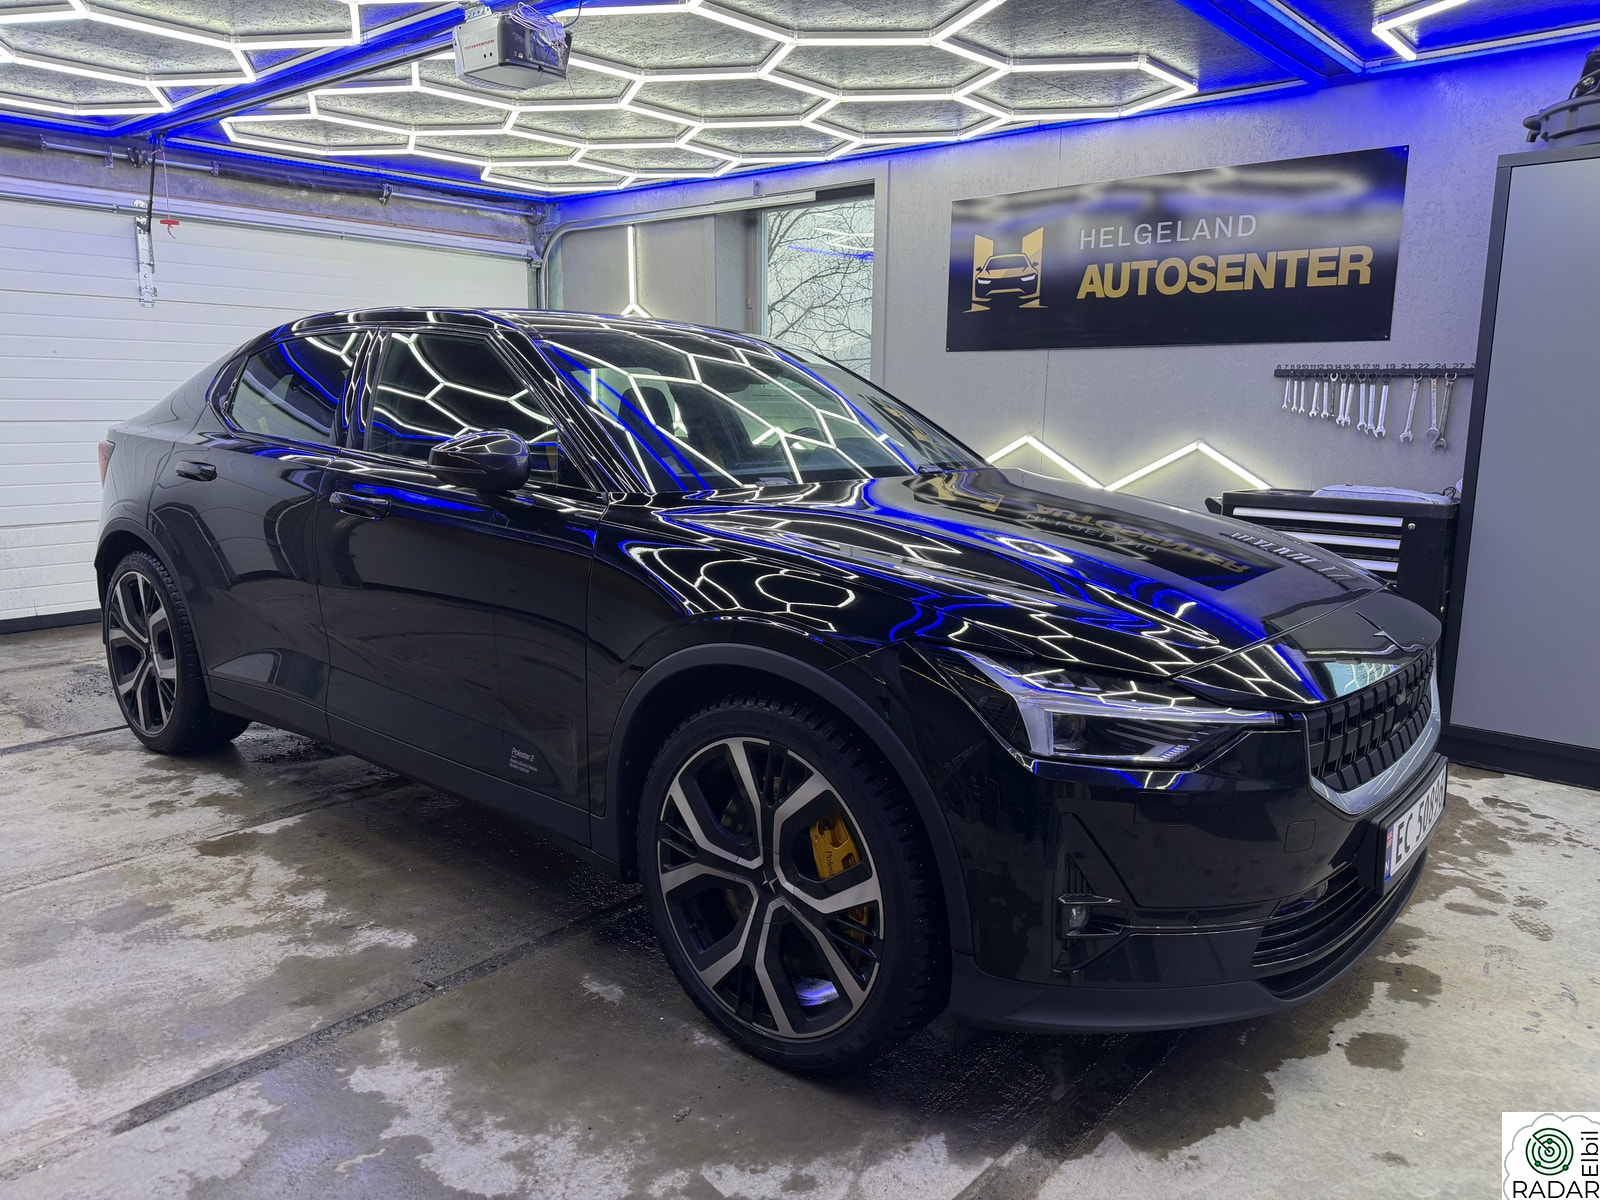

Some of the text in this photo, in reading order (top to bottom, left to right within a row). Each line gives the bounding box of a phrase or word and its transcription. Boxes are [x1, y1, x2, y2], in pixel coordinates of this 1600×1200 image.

[1080, 214, 1257, 250] HELGELAND
[1076, 245, 1374, 300] AUTOSENTER
[1396, 812, 1414, 865] EC
